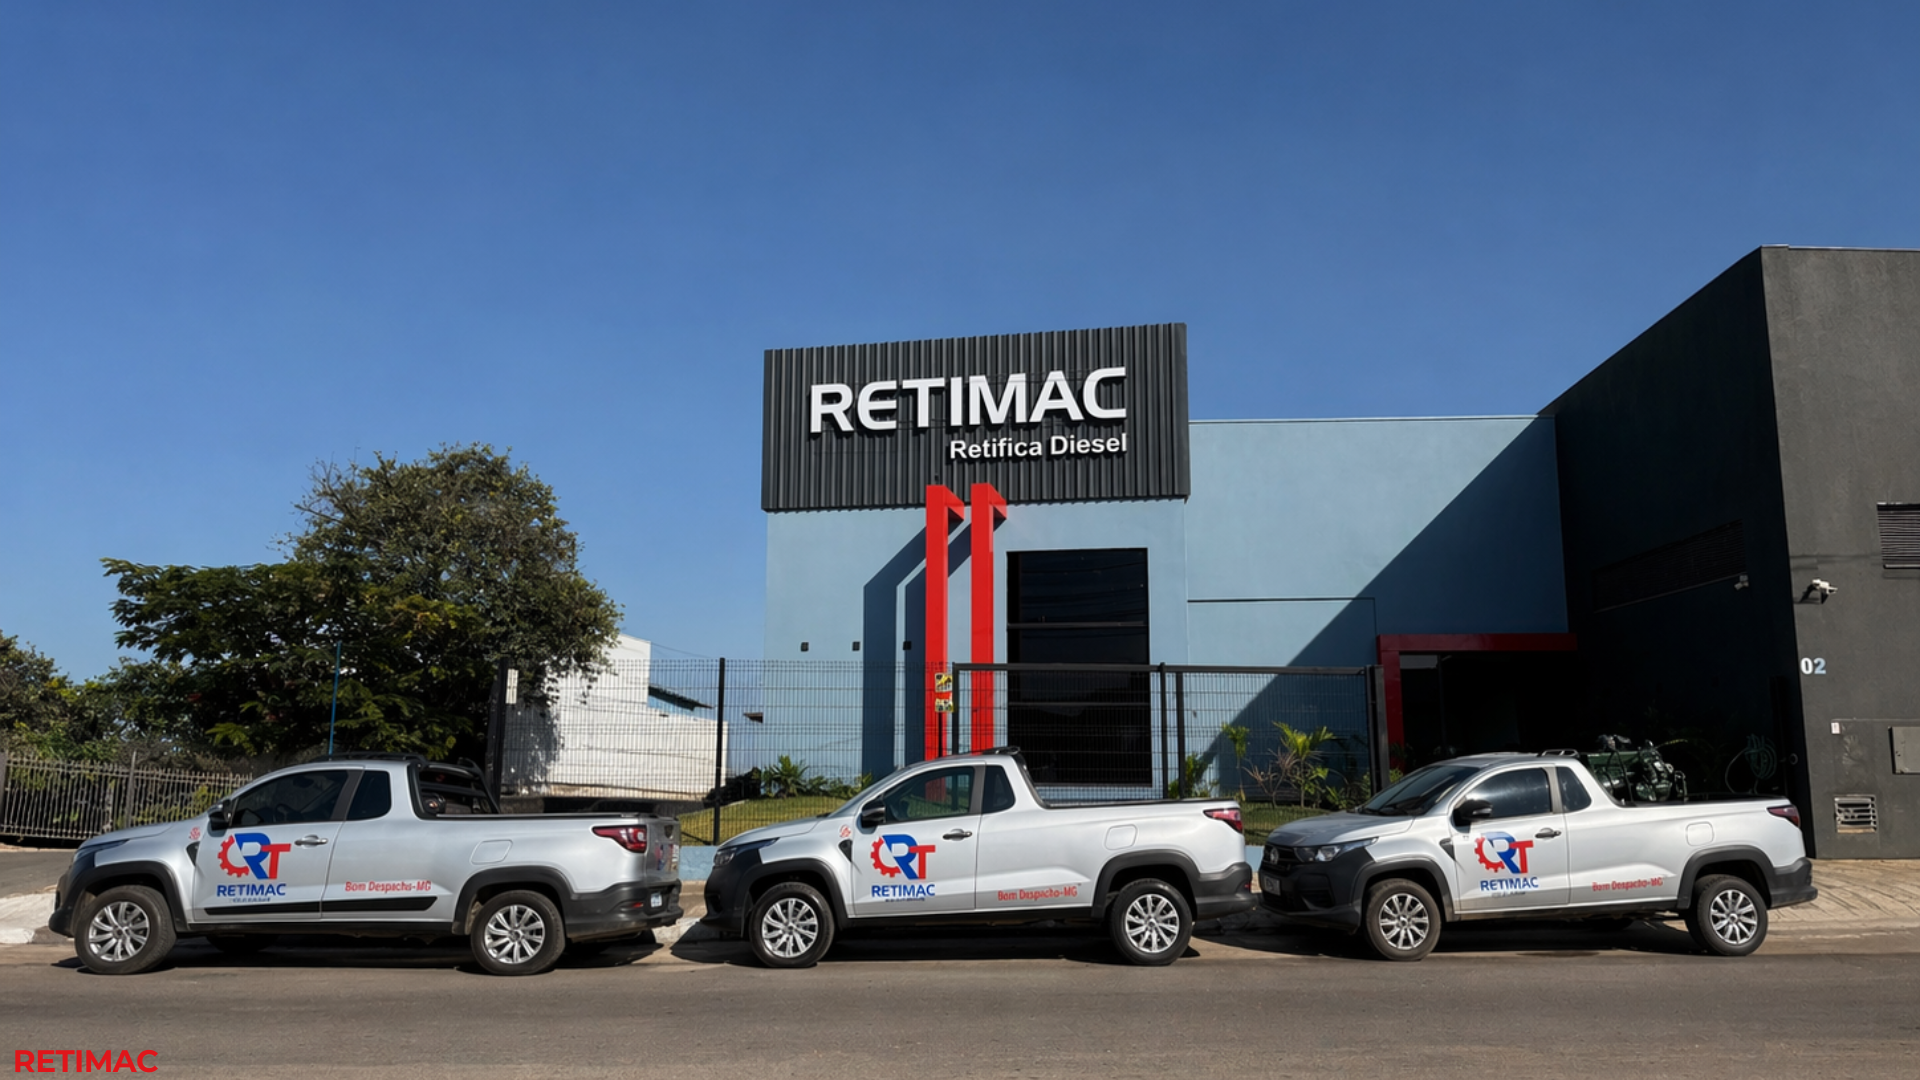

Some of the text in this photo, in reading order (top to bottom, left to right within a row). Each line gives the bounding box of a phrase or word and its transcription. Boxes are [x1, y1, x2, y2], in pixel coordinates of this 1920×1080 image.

[809, 366, 1127, 434] RETIMAC
[949, 432, 1128, 460] Retifica Diesel
[1800, 657, 1827, 675] 02
[216, 883, 287, 897] RETIMAC
[871, 884, 936, 898] RETIMAC
[1480, 876, 1539, 891] RETIMAC
